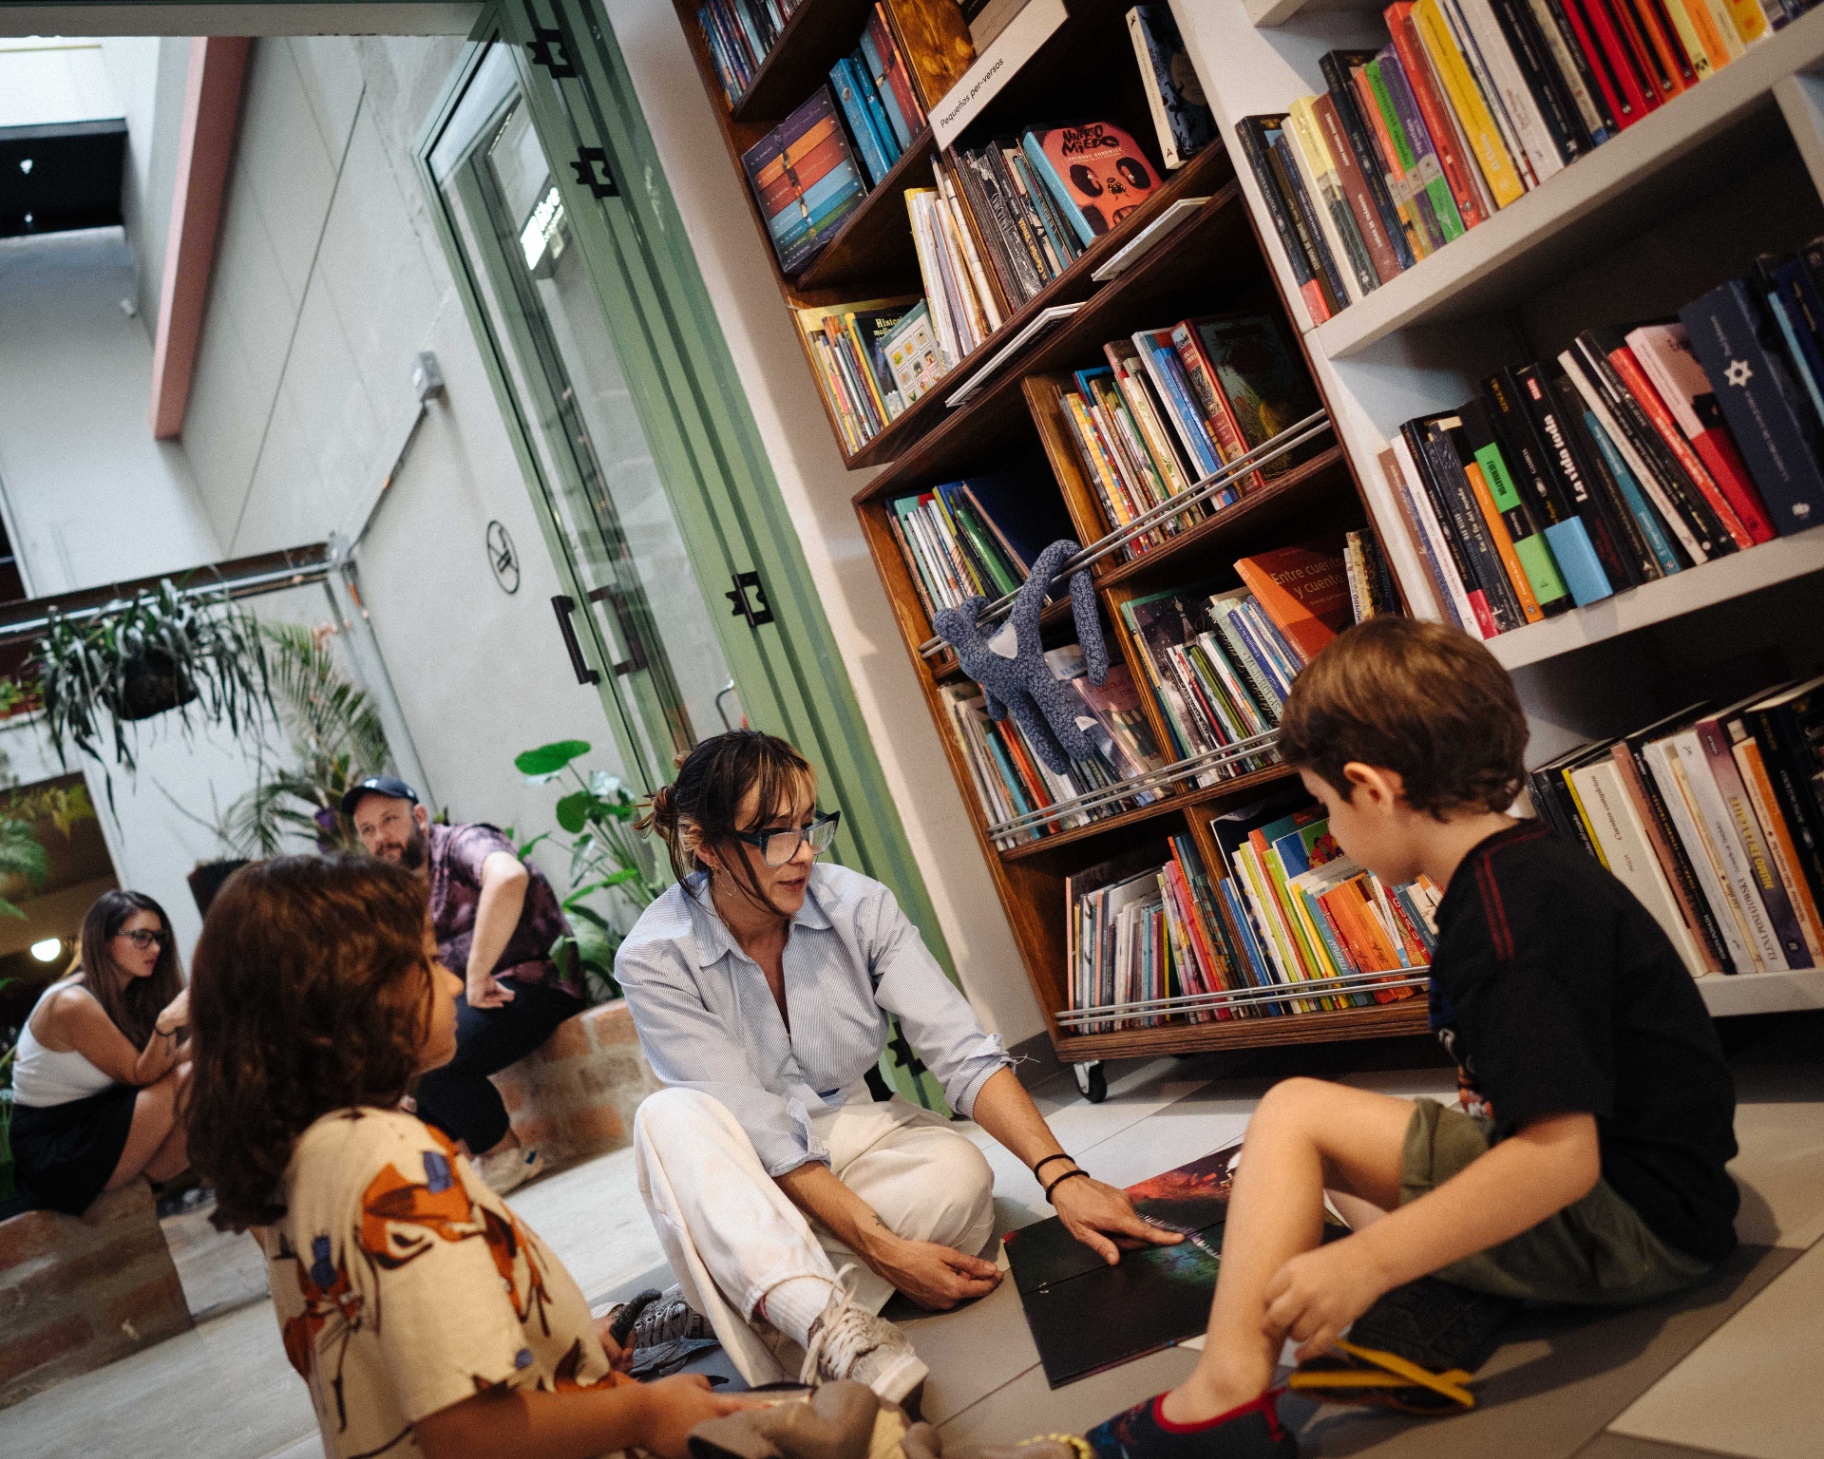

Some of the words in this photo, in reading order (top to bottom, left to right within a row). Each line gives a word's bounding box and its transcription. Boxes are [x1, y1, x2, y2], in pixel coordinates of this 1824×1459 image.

[939, 93, 971, 129] Pequeños
[970, 58, 1005, 99] per-versos
[1061, 136, 1119, 156] MIEDO
[1062, 125, 1104, 143] MUERTO
[1333, 133, 1344, 152] MIGUEL
[1404, 117, 1424, 153] reportajes
[1340, 152, 1350, 166] JUAN
[1355, 193, 1372, 221] TRÁNSITO
[1367, 220, 1375, 228] DE
[1371, 228, 1383, 247] LUGAR
[1540, 413, 1565, 450] toda
[1521, 448, 1536, 475] GAMBOA
[1555, 447, 1579, 482] vida
[1486, 459, 1506, 496] FUENMAYOR
[1455, 486, 1470, 510] mundo
[1569, 479, 1588, 503] La
[1465, 510, 1475, 522] del
[1469, 522, 1479, 533] fin
[1474, 533, 1482, 541] el
[1477, 540, 1487, 552] En
[1270, 569, 1305, 585] Entre
[1305, 558, 1344, 575] cuento
[1293, 586, 1303, 599] y
[1304, 574, 1344, 593] cuento
[1242, 654, 1282, 710] MUJERCITAS
[1588, 774, 1612, 812] completos
[1604, 811, 1623, 841] Cuentos
[1736, 876, 1767, 936] PONIATOWSKA
[1702, 913, 1718, 939] POSADA
[1760, 934, 1778, 962] ELENA
